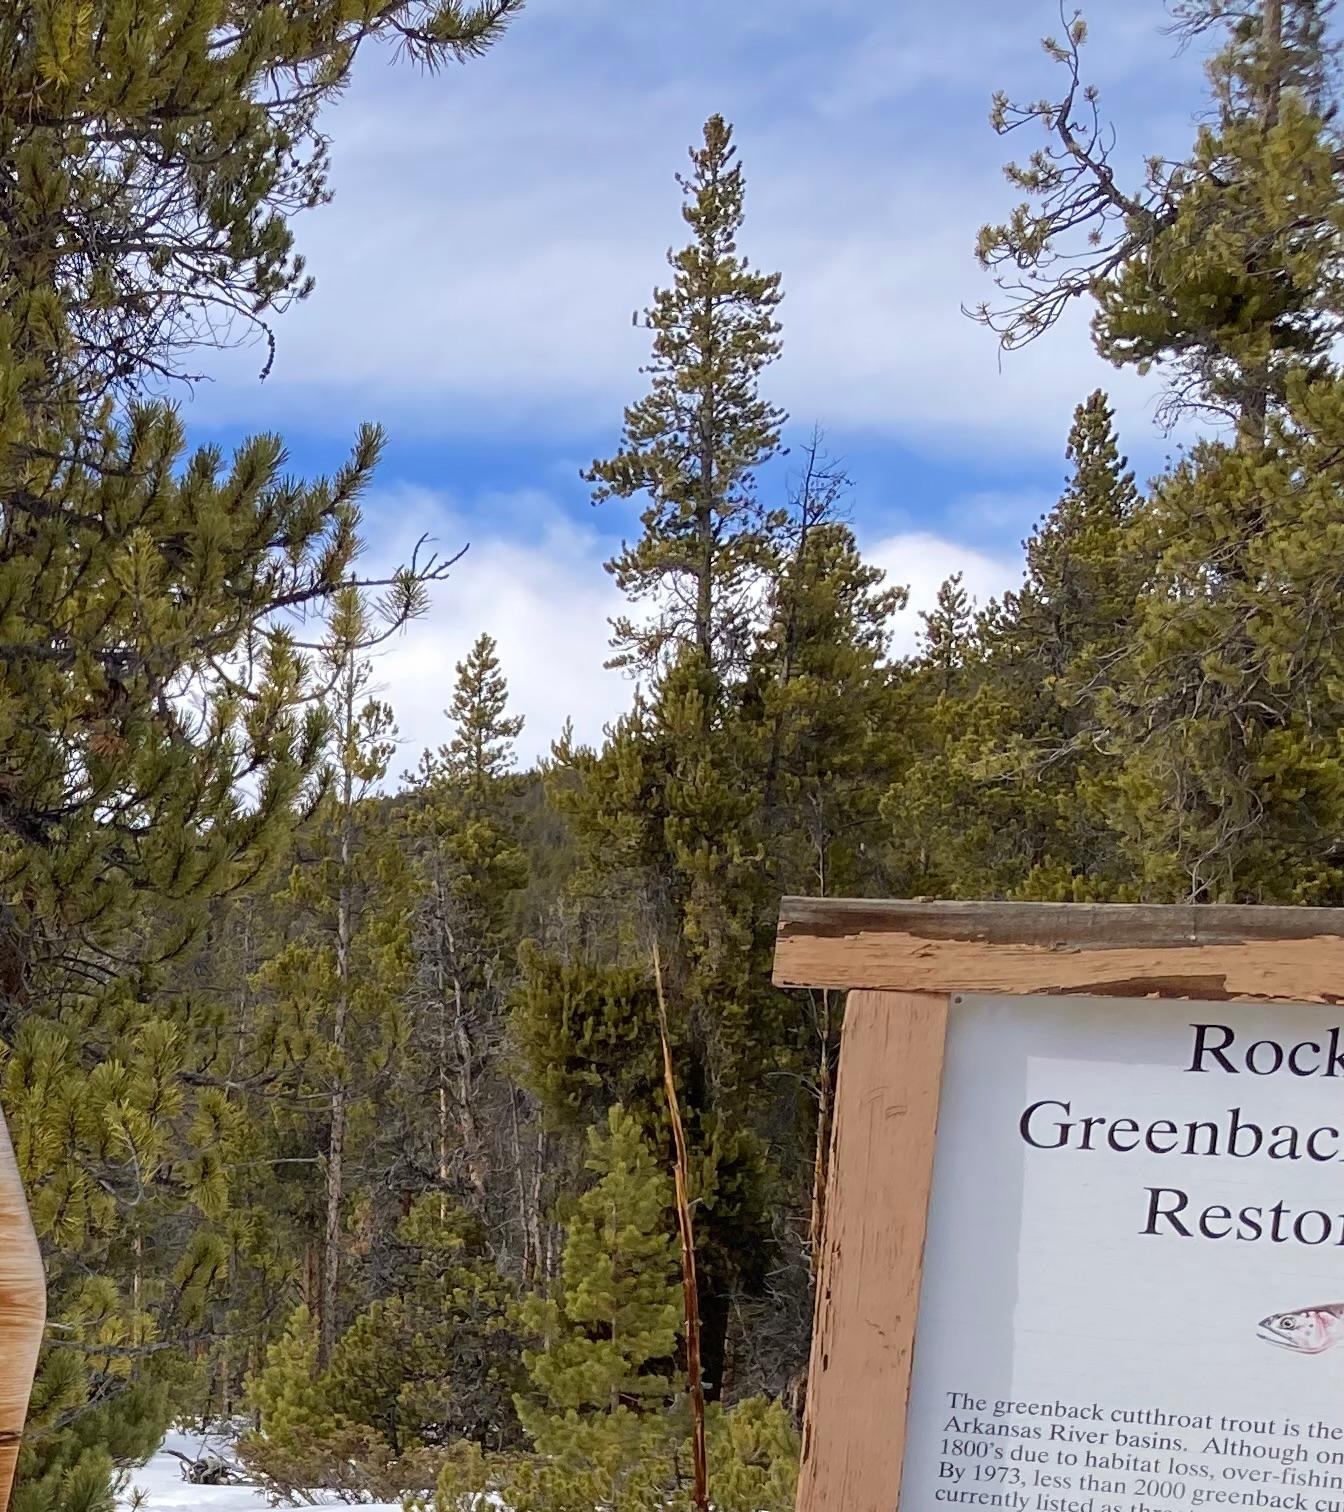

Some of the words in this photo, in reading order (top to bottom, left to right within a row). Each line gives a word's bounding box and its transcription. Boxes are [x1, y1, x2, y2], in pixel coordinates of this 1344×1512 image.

[1019, 1100, 1344, 1163] Greenbac
[941, 1414, 1042, 1440] Arkansas
[1046, 1422, 1110, 1445] River
[1114, 1427, 1188, 1452] basins.
[1200, 1435, 1309, 1466] Although
[945, 1390, 987, 1412] The
[991, 1399, 1105, 1422] greenback
[1109, 1406, 1214, 1430] cutthroat
[1219, 1414, 1276, 1435] trout
[1281, 1417, 1301, 1438] is
[1306, 1419, 1344, 1441] the
[936, 1460, 966, 1484] By
[972, 1463, 1026, 1489] 1973,
[1031, 1468, 1072, 1490] less
[1078, 1472, 1126, 1495] than
[1132, 1477, 1186, 1500] 2000
[1189, 1487, 1309, 1511] greenback
[939, 1437, 1004, 1460] 1800's
[1008, 1442, 1050, 1464] due
[1055, 1448, 1078, 1466] to
[1082, 1448, 1161, 1474] habitat
[1166, 1455, 1215, 1481] loss,
[1221, 1465, 1344, 1494] over-fishin
[933, 1487, 1030, 1512] currently
